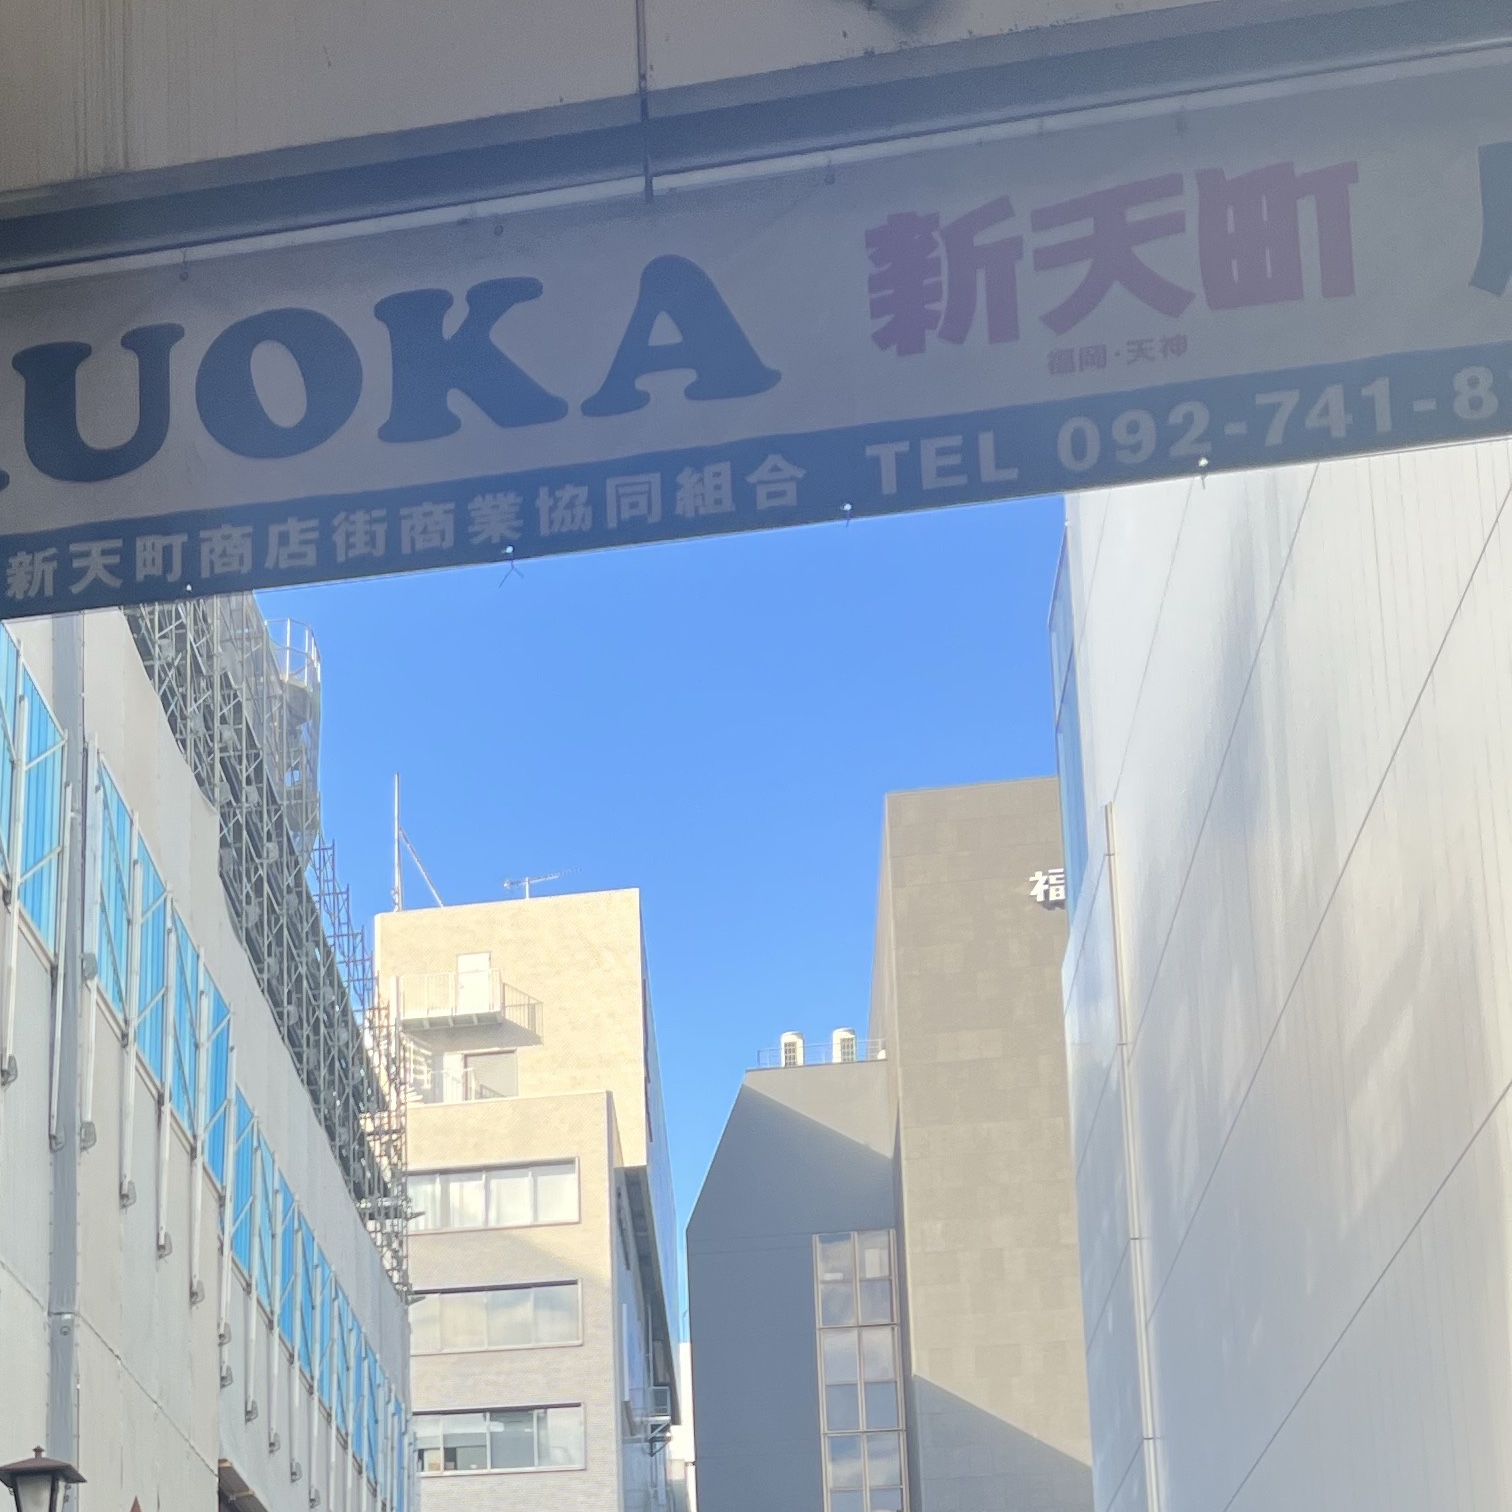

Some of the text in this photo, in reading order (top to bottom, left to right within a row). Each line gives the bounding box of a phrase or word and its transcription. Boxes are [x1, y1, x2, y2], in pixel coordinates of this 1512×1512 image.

[863, 160, 1360, 357] 新天町
[5, 453, 807, 602] 新天町商店街商業協同組合
[864, 429, 1020, 496] TEL
[1056, 364, 1504, 473] 092-741-8
